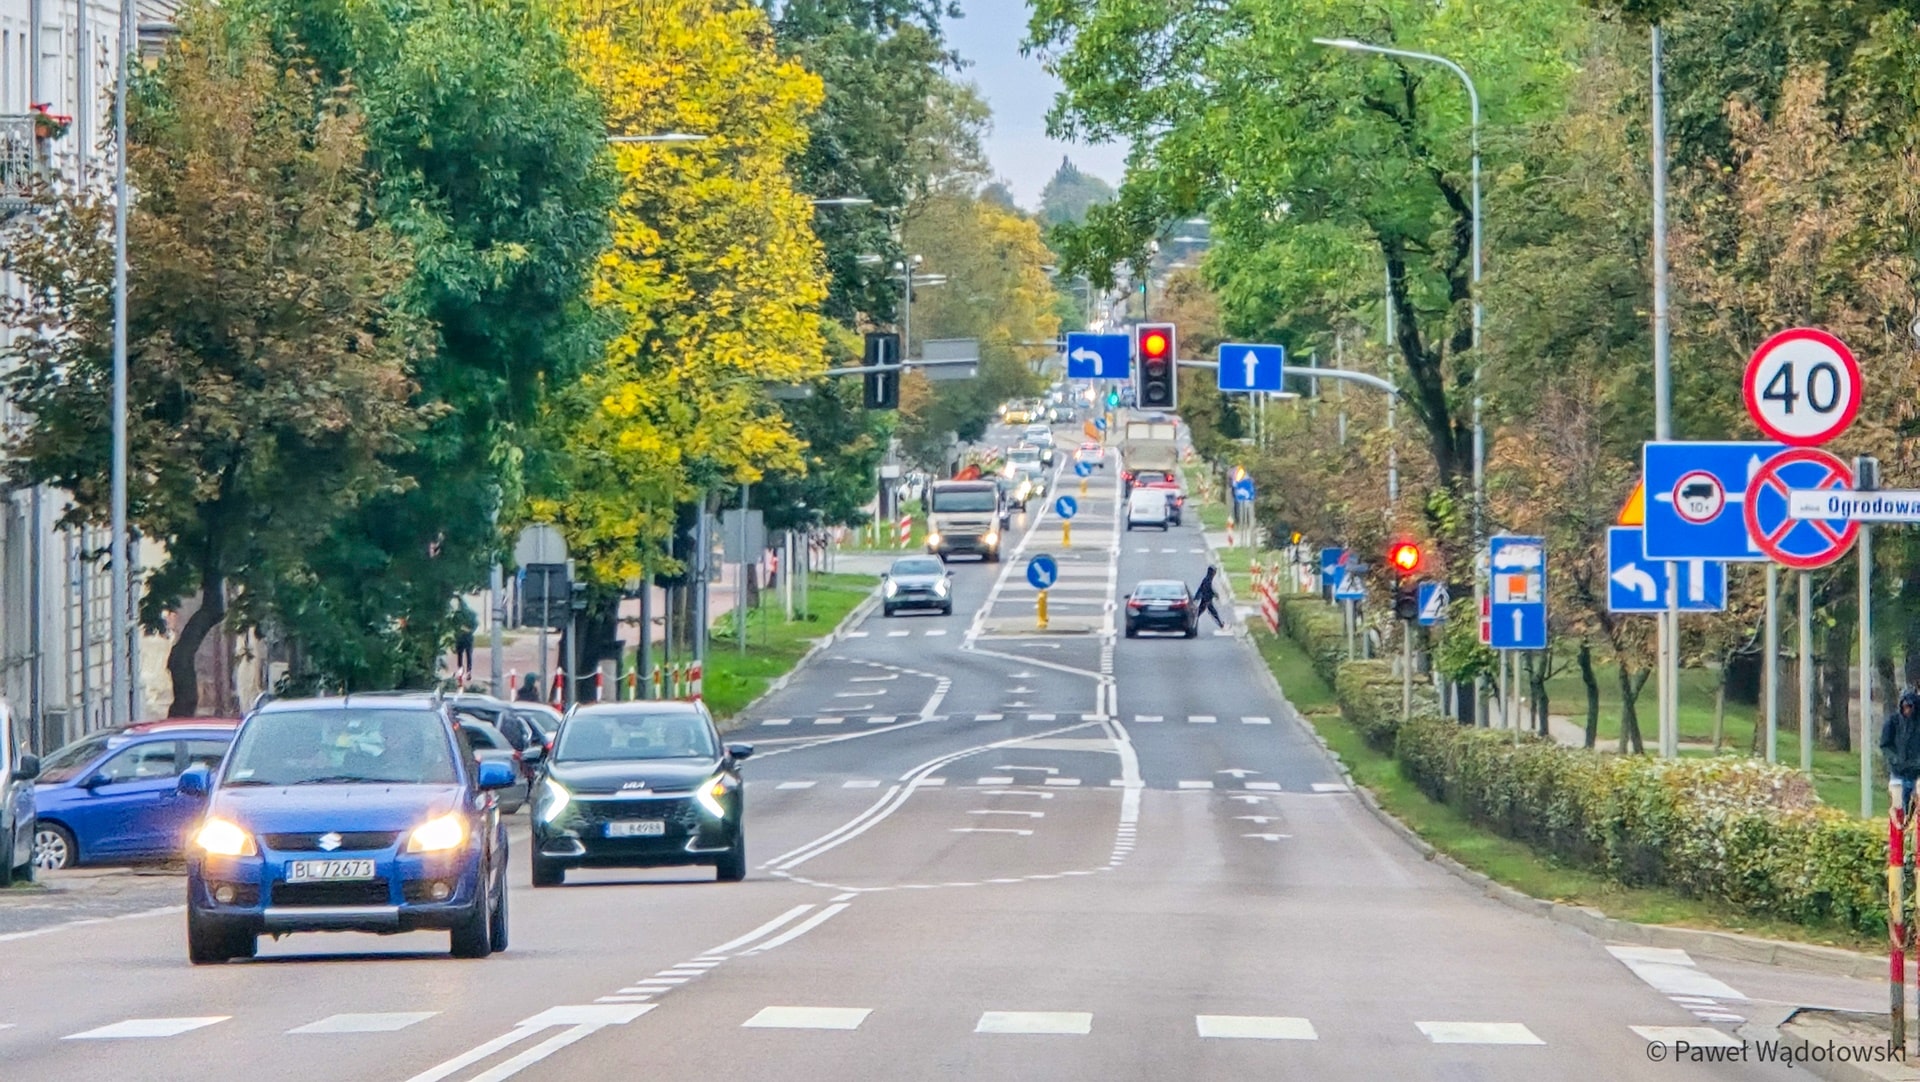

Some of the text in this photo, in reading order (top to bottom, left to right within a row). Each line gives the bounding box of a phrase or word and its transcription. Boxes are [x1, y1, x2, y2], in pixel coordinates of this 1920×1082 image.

[1763, 361, 1841, 414] 40
[1828, 496, 1920, 517] Ogrodowa
[295, 861, 371, 878] BL 72673
